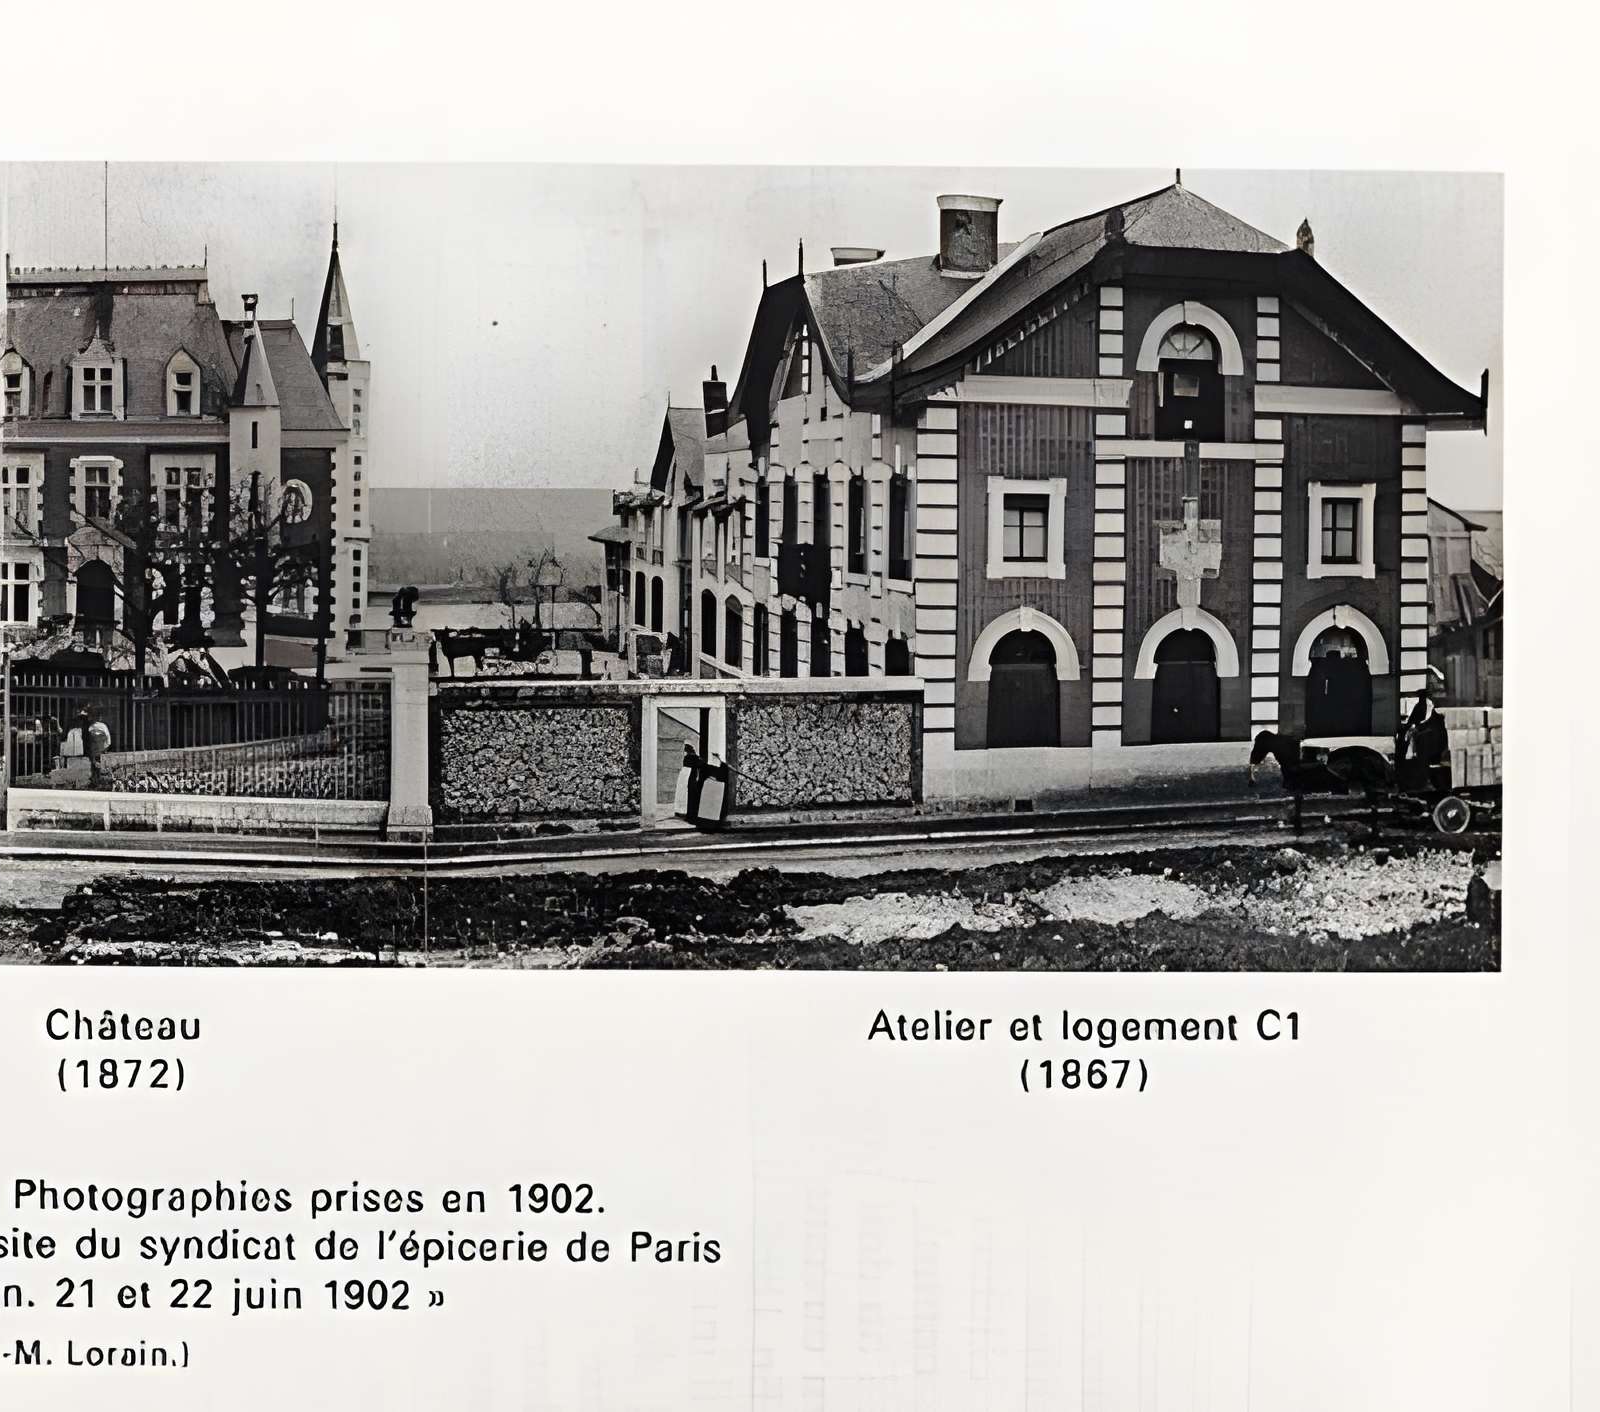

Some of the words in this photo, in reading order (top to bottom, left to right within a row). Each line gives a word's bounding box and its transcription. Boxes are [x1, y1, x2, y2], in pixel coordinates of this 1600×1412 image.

[45, 1008, 200, 1041] Château
[867, 1009, 993, 1042] Atelier
[1009, 1014, 1043, 1042] et
[1062, 1009, 1238, 1049] logement
[1256, 1008, 1299, 1041] C1
[57, 1058, 185, 1093] (1872)
[1020, 1058, 1148, 1093] (1867)
[15, 1178, 292, 1219] Photographies
[311, 1180, 424, 1220] prises
[442, 1190, 485, 1213] en
[508, 1182, 605, 1214] 1902.
[75, 1227, 121, 1260] du
[140, 1228, 296, 1267] syndicat
[314, 1229, 359, 1261] de
[378, 1229, 548, 1269] l'épicerie
[566, 1231, 610, 1263] de
[631, 1231, 721, 1264] Paris
[55, 1277, 94, 1308] 21
[117, 1282, 151, 1309] et
[169, 1278, 213, 1309] 22
[231, 1277, 302, 1317] juin
[324, 1279, 410, 1311] 1902
[67, 1340, 189, 1368] Lorain.)
